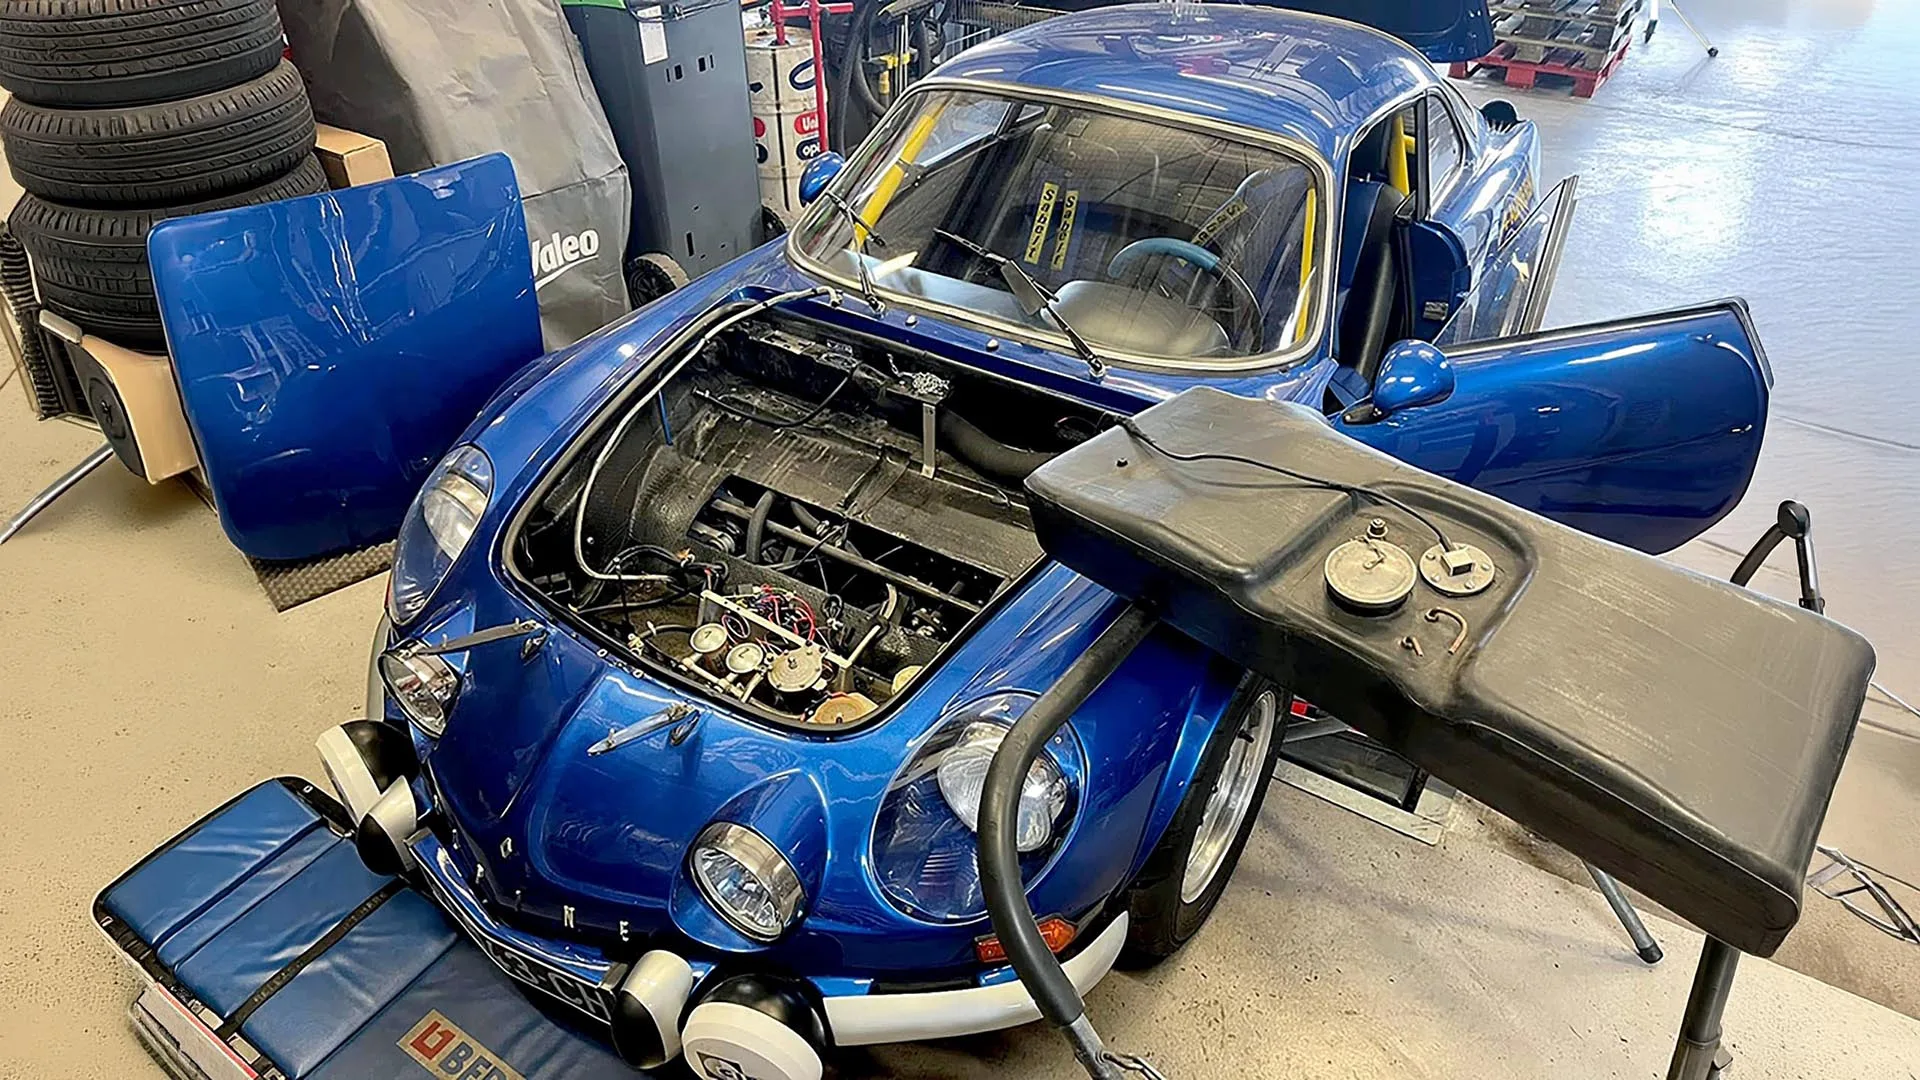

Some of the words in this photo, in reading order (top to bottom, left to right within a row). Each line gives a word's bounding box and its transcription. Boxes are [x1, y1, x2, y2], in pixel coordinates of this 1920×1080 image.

[1028, 189, 1055, 258] Sabelt
[1053, 195, 1076, 265] Sabelt
[1191, 204, 1241, 245] Sabe
